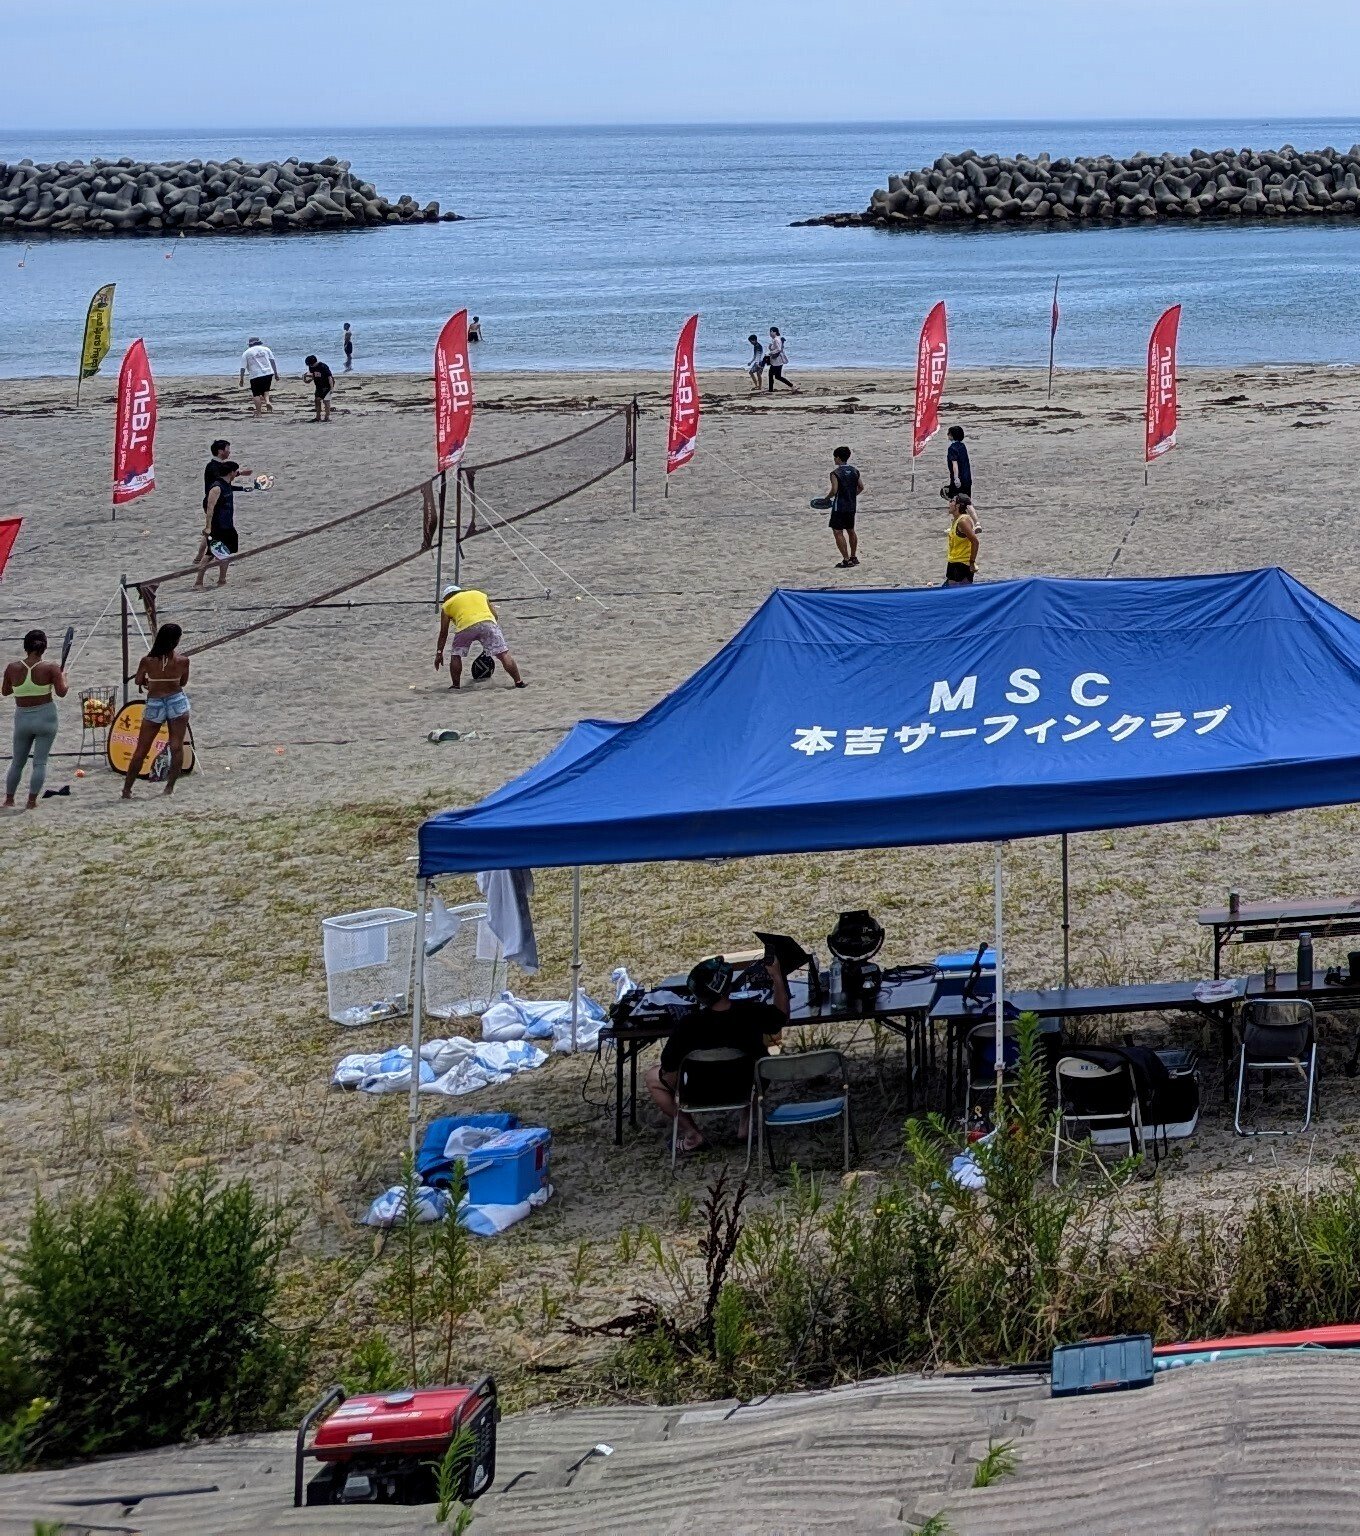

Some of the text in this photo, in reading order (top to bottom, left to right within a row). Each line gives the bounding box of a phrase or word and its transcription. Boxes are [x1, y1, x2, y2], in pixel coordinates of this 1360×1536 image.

[790, 703, 1232, 757] 本吉サーフィンクラブ
